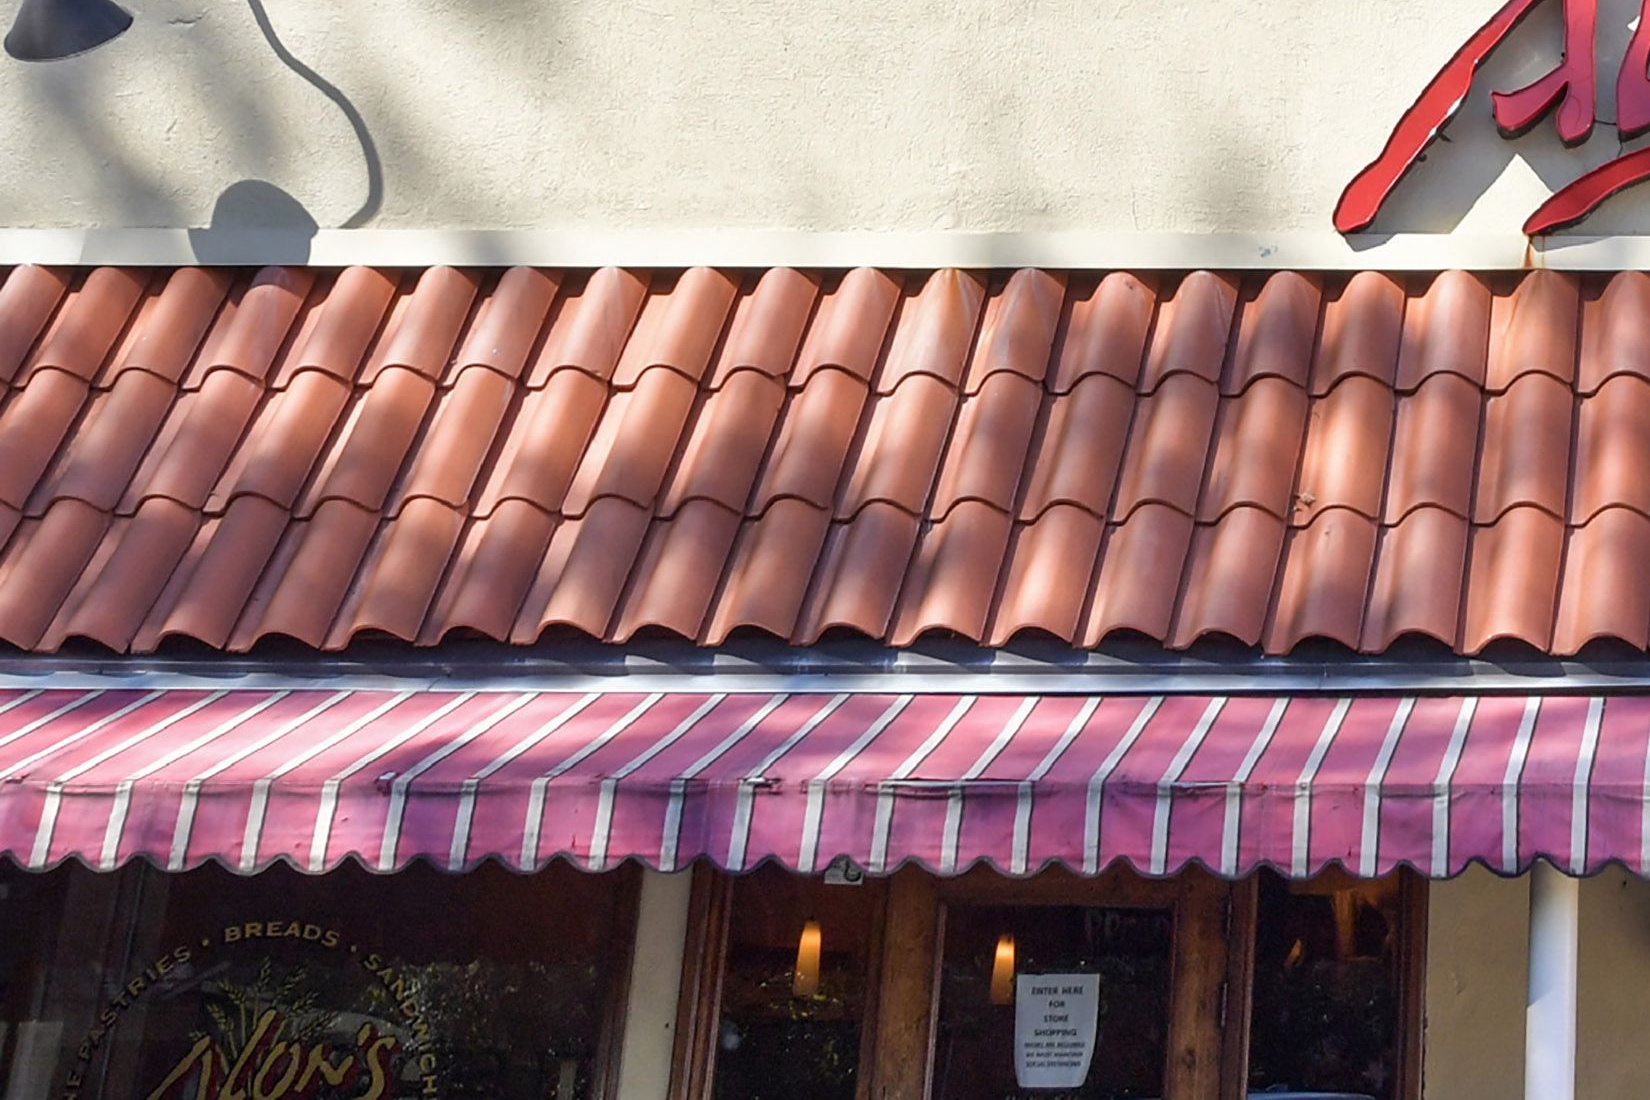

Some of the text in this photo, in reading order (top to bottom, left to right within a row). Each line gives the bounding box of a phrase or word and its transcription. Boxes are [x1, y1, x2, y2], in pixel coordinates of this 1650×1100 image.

[1031, 986, 1084, 995] ENTER HERE
[1048, 1000, 1065, 1008] FOR
[78, 921, 438, 1100] PASTRIES BREADS SANDWICH
[1043, 1013, 1069, 1022] STORE
[1034, 1028, 1077, 1036] SHOPPING
